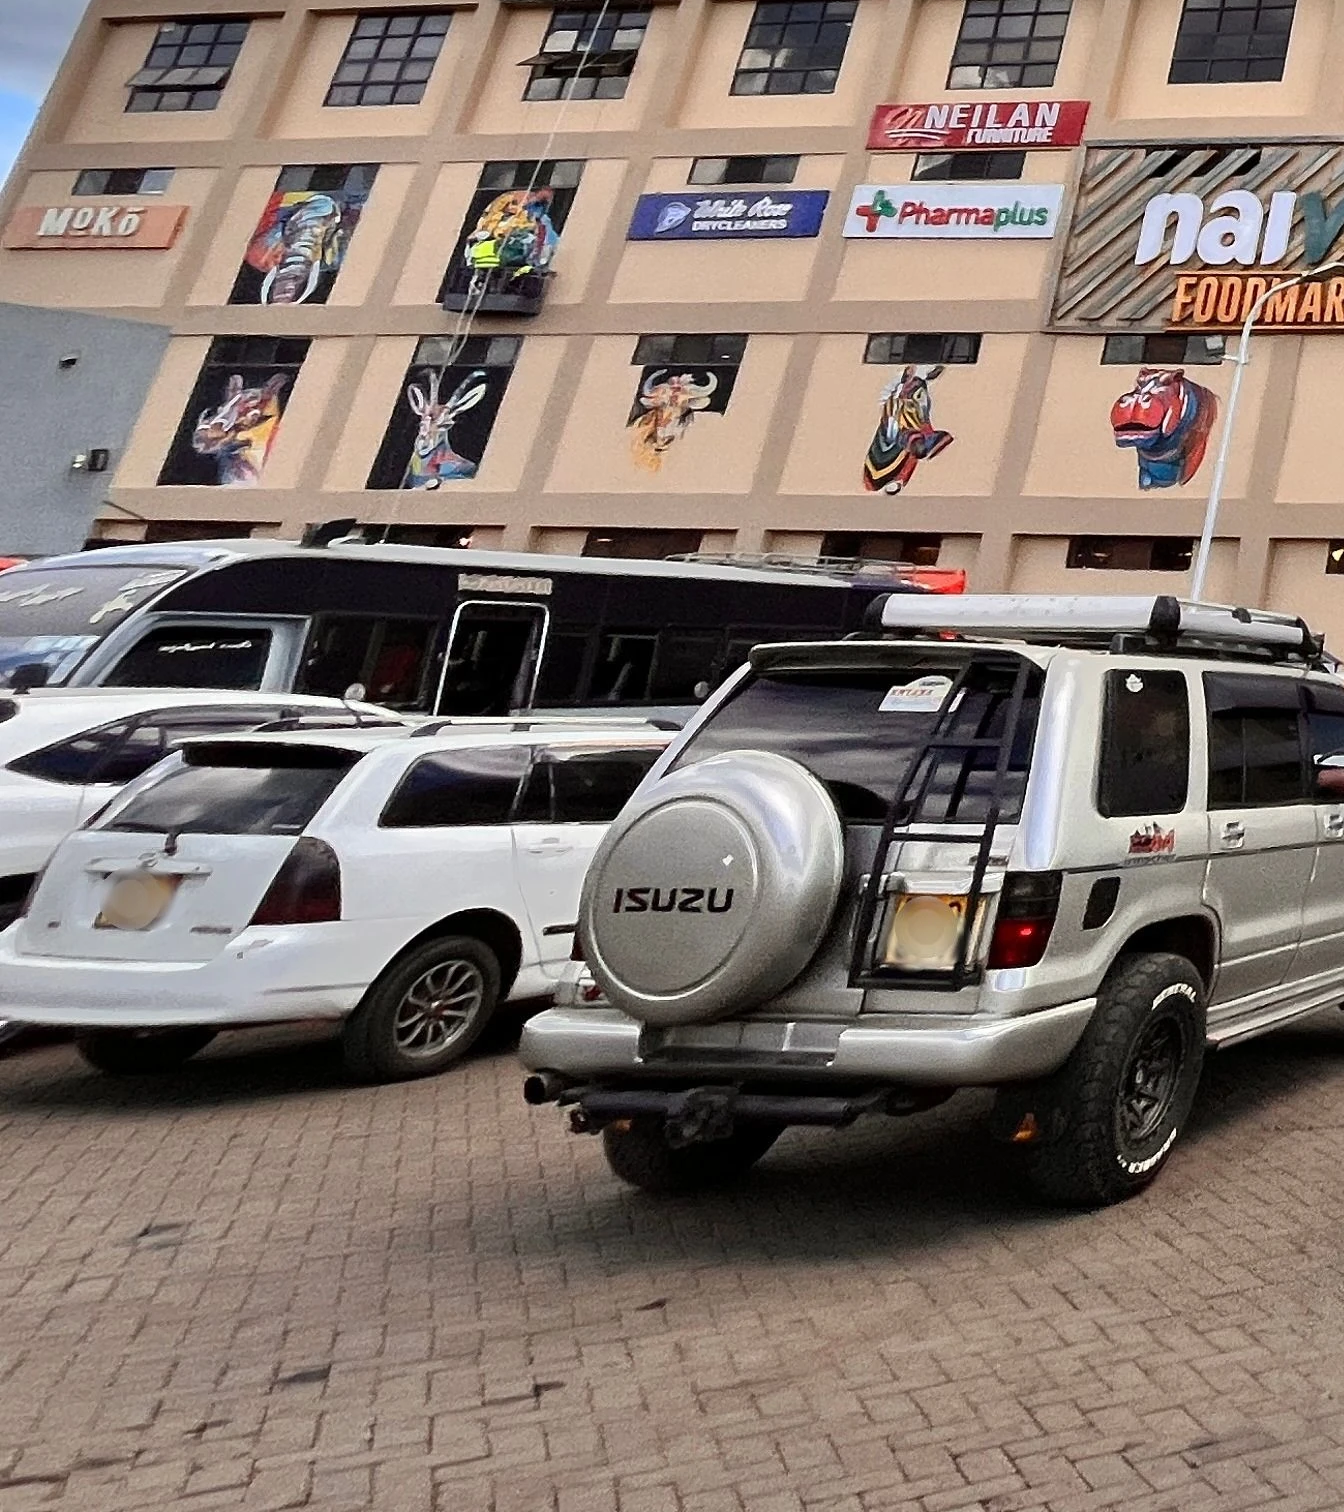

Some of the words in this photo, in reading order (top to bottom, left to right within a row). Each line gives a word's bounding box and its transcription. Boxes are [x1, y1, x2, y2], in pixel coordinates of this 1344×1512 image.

[924, 102, 1061, 130] NEILAN
[966, 127, 1053, 144] FURNITURE
[692, 218, 788, 232] DRYCLEANERS
[898, 200, 1049, 232] Pharmaplus
[613, 887, 734, 913] ISUZU
